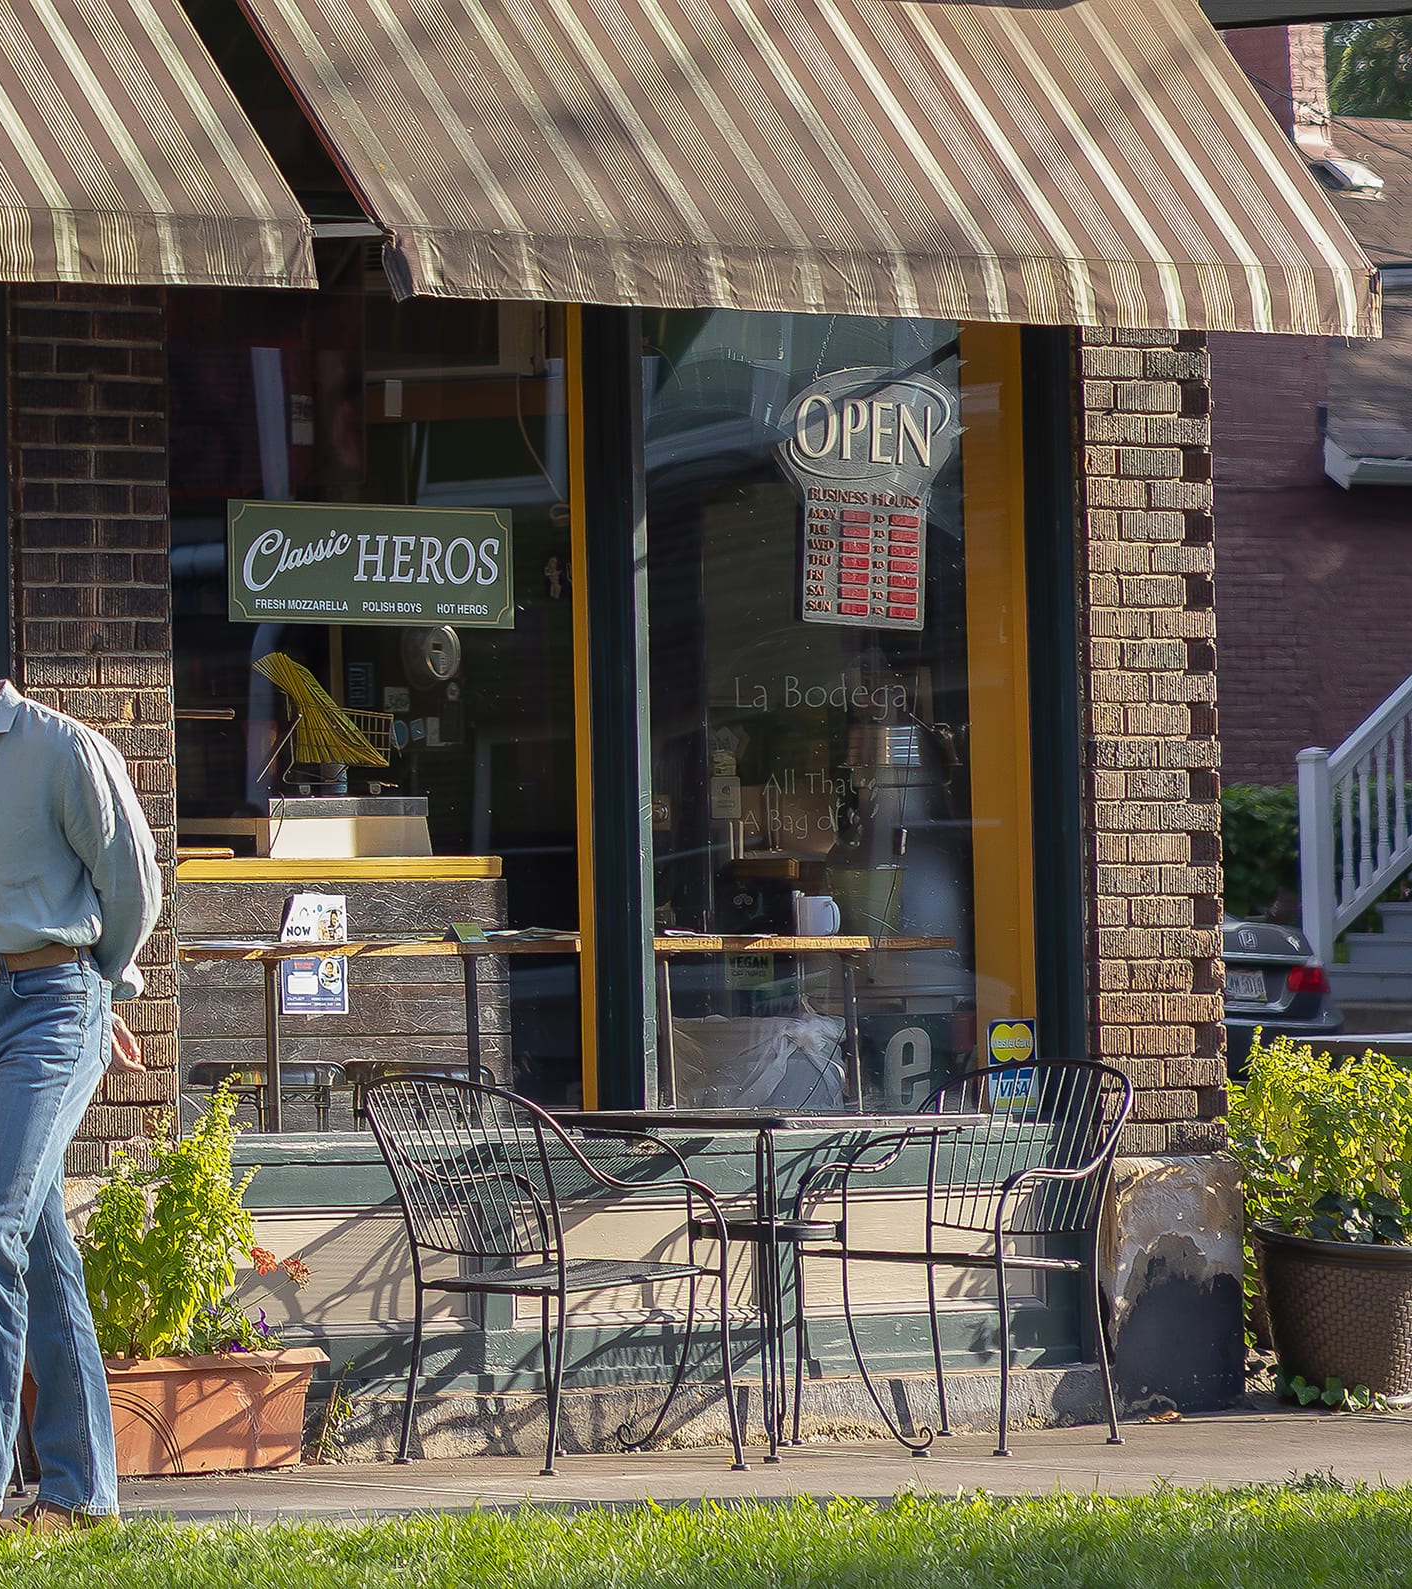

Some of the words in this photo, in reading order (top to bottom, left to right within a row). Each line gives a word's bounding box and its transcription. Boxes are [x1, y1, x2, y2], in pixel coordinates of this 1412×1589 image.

[795, 393, 932, 467] OPEN
[808, 486, 869, 504] BUSINESS
[872, 492, 921, 509] HOURS
[808, 539, 835, 550] WED
[242, 529, 352, 592] Classic
[353, 534, 500, 586] HEROS
[255, 598, 286, 610] FRESH
[288, 599, 348, 611] MOZZARELLA
[362, 601, 395, 612] POLISH
[397, 602, 422, 613] BOYS
[437, 603, 456, 614] HOT
[457, 604, 488, 615] HEROS
[806, 599, 831, 612] SUN
[734, 677, 769, 711] La
[785, 673, 907, 721] Bodega
[762, 769, 795, 796] All
[804, 768, 856, 796] That
[742, 811, 761, 832] A
[771, 810, 808, 840] Bag
[286, 926, 311, 936] NOW
[730, 956, 768, 968] VEGAN
[885, 1027, 932, 1112] e
[1001, 1081, 1028, 1097] VISA
